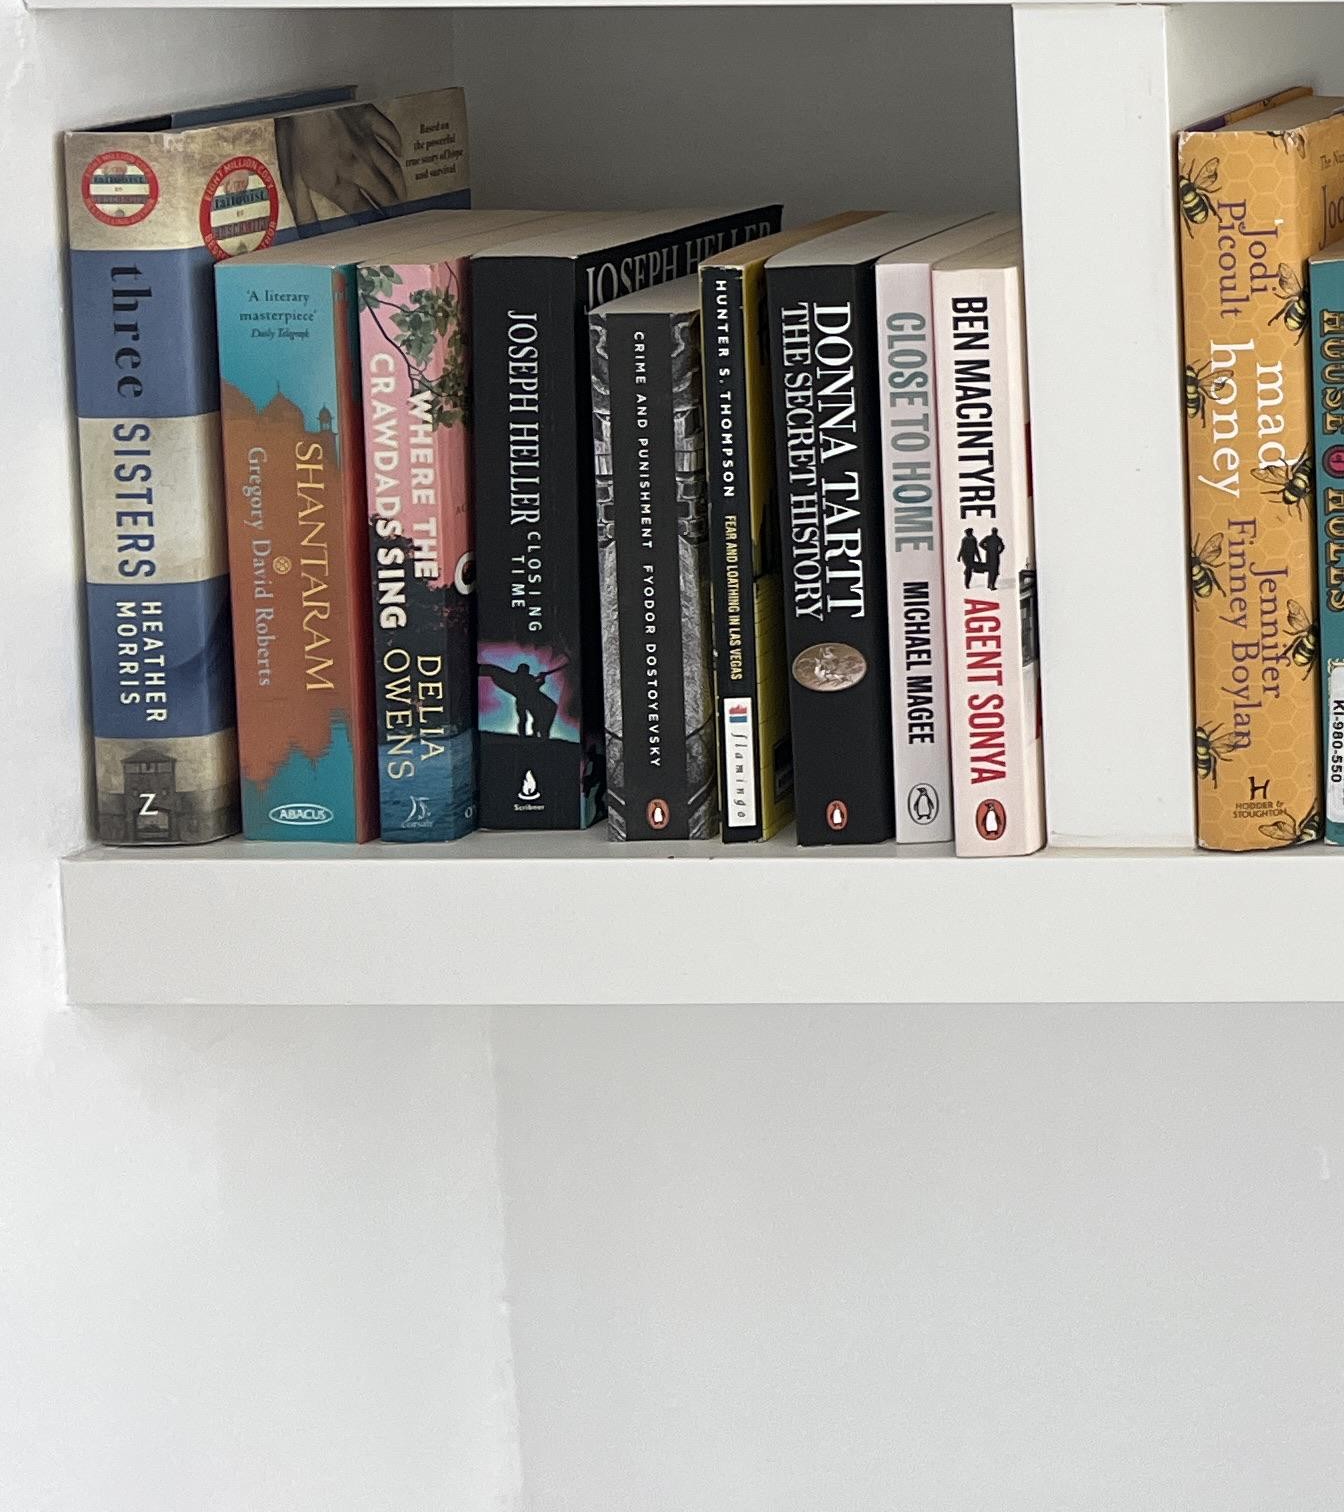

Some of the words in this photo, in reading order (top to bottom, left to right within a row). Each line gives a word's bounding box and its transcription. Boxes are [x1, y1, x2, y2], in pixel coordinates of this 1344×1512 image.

[109, 263, 154, 399] three
[265, 290, 309, 307] literary
[508, 310, 538, 413] JOSEPH
[633, 332, 646, 386] CRIME
[636, 393, 648, 428] AND
[812, 303, 858, 464] DONNA
[1256, 359, 1296, 472] mad
[509, 422, 540, 526] HELLER
[1198, 339, 1254, 499] honey
[112, 423, 158, 579] SISTERS
[638, 436, 652, 549] PUNISHMENT
[822, 472, 865, 618] TARTT
[295, 442, 335, 693] SHANTARAM
[115, 600, 140, 706] MORRIS
[141, 602, 168, 723] HEATHER
[416, 654, 446, 762] DELIA
[382, 648, 415, 780] OWENS
[1331, 698, 1344, 783] KI-980-550
[280, 808, 325, 822] ABACUS
